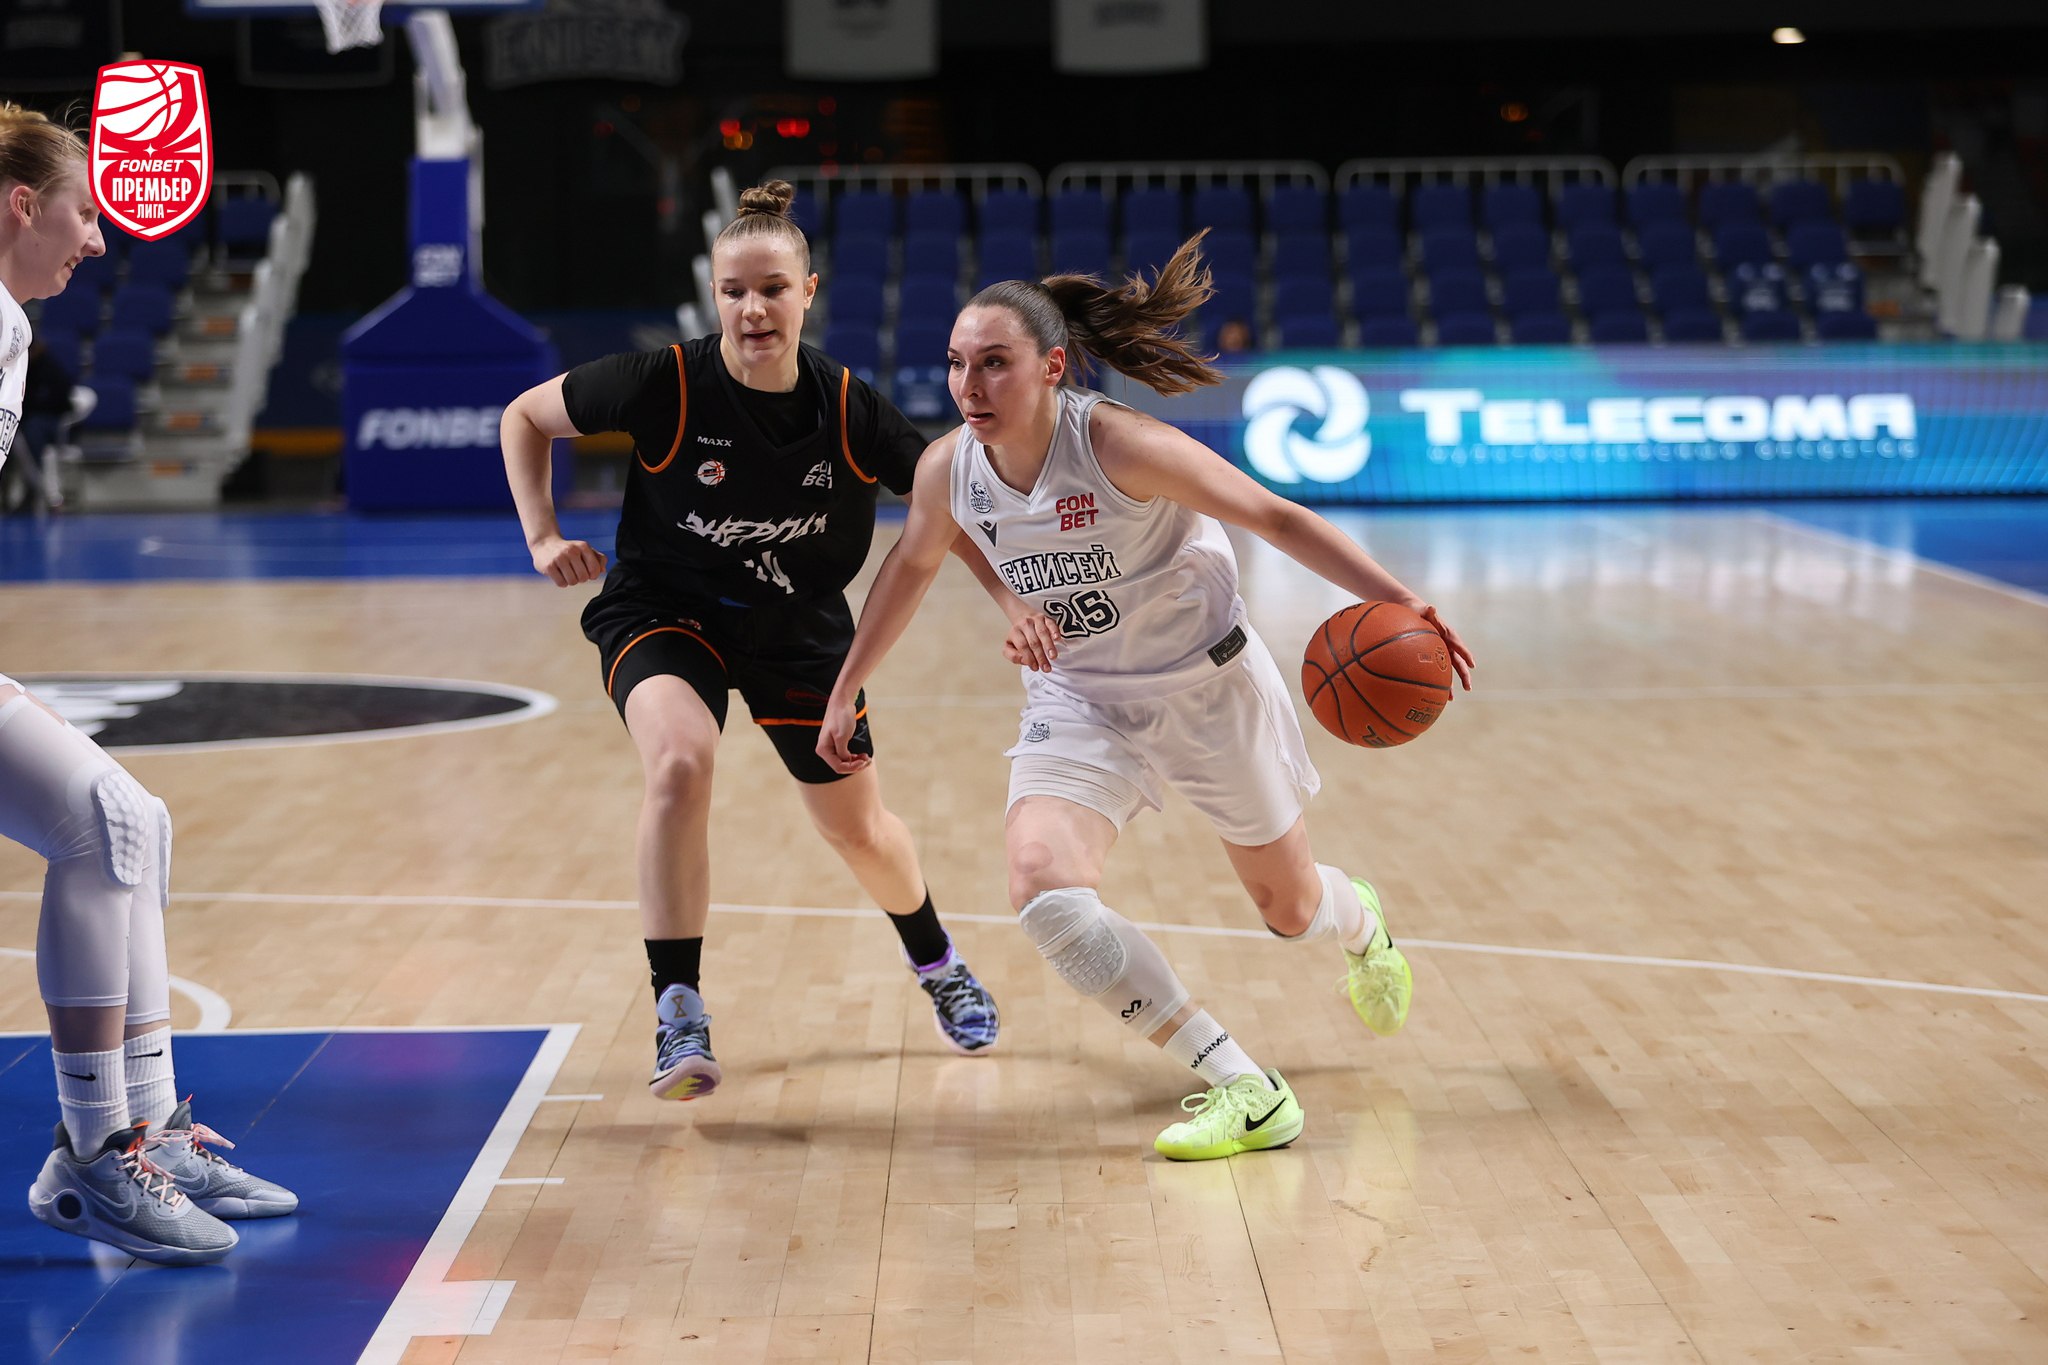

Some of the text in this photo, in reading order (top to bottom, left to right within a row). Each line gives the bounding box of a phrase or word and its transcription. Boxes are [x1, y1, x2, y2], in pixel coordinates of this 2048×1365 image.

[356, 407, 504, 449] FONBE
[1400, 388, 1917, 444] TELECOMA
[697, 436, 732, 447] MAXX
[1055, 492, 1095, 514] FON
[1060, 509, 1099, 532] BET
[1000, 544, 1122, 595] ЕНИСЕЙ
[1044, 590, 1120, 638] 25
